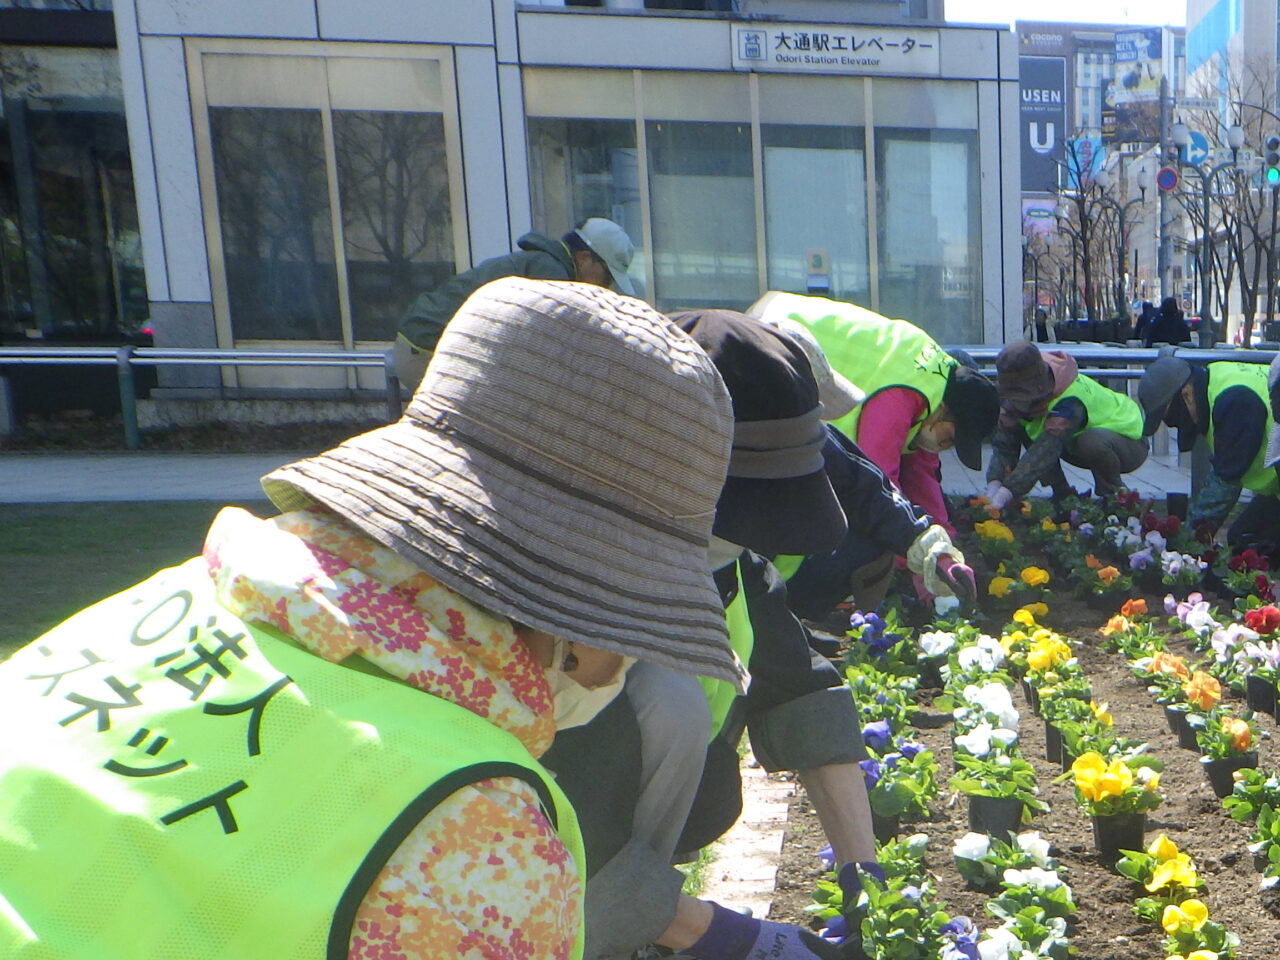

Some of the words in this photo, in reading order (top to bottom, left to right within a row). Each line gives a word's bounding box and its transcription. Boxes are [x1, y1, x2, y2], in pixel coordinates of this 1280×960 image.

[774, 32, 933, 54] 大通駅エレベーター
[775, 54, 802, 63] Odori
[804, 55, 839, 65] Station
[841, 56, 880, 66] Elevator
[1022, 89, 1061, 103] USEN
[1029, 122, 1055, 153] U
[130, 578, 295, 757] O法人
